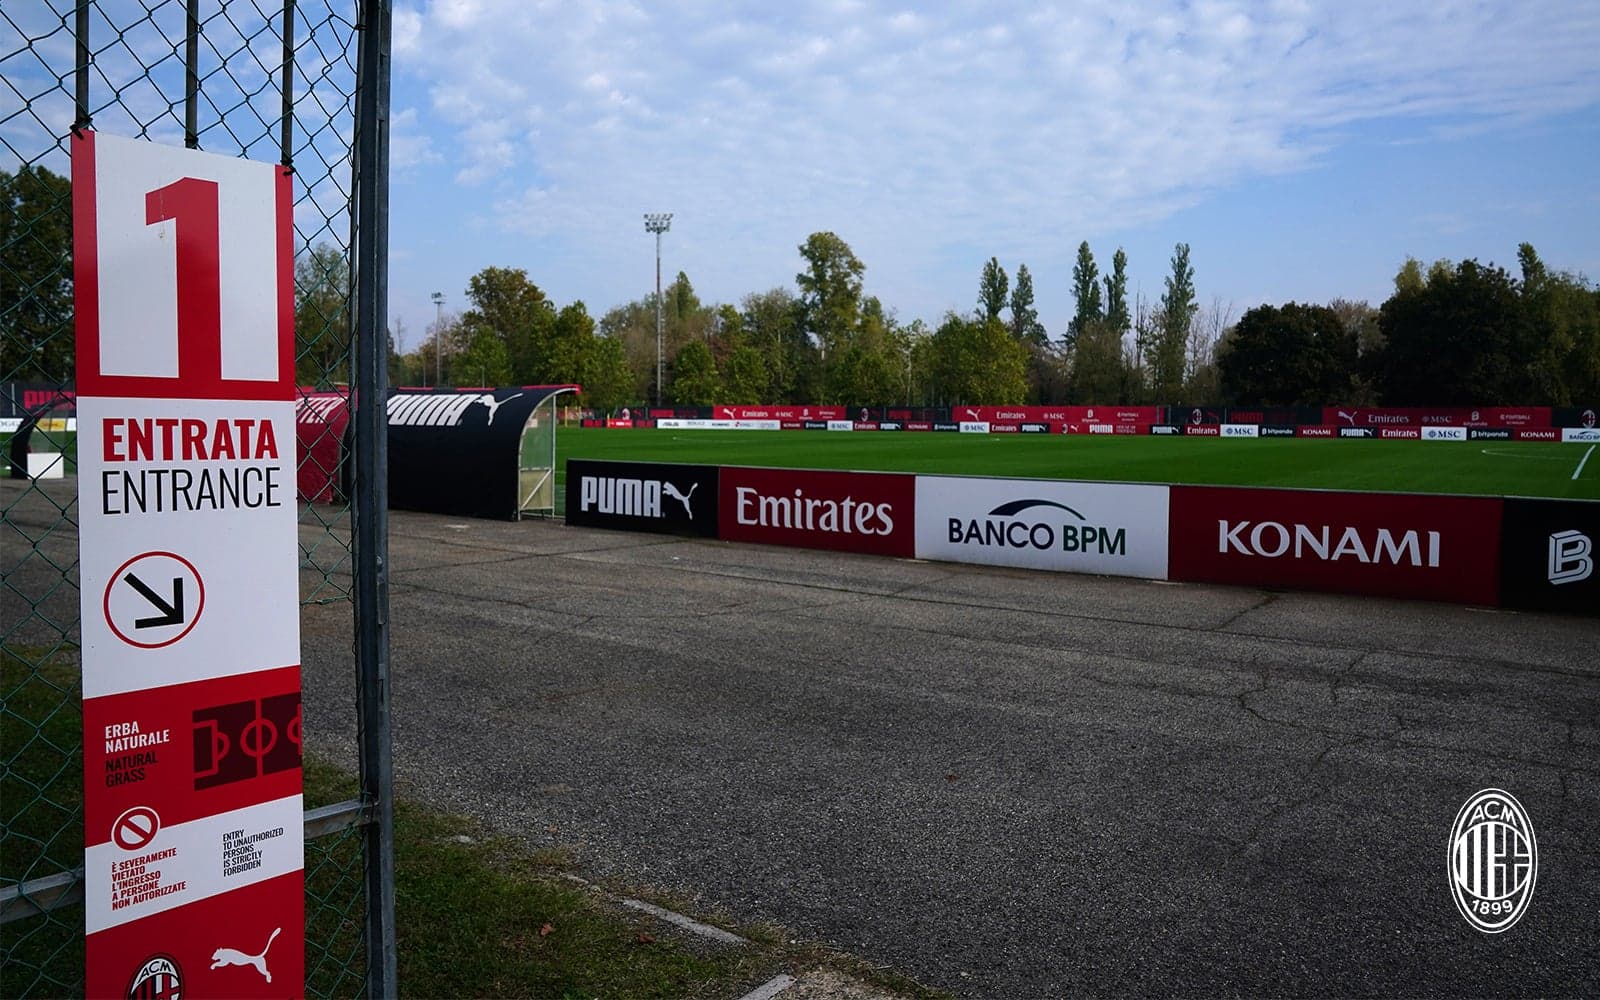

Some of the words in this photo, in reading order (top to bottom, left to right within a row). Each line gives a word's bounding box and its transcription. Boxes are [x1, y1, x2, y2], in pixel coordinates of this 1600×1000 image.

[145, 177, 222, 379] 1
[996, 411, 1026, 419] Emirates
[1368, 414, 1410, 424] Emirates
[1430, 415, 1452, 423] MSC
[991, 424, 1017, 432] Emirates
[1089, 424, 1113, 433] PUMA
[1187, 426, 1217, 435] Emirates
[1233, 427, 1253, 436] MSC
[1341, 428, 1365, 436] PUMA
[1382, 428, 1418, 438] Emirates
[1437, 430, 1461, 438] MSC
[103, 418, 278, 462] ENTRATA
[102, 467, 281, 515] ENTRANCE
[581, 476, 662, 518] PUMA
[736, 486, 894, 536] Emirates
[948, 518, 1055, 550] BANCO
[1062, 525, 1126, 556] BPM
[1218, 519, 1441, 567] KONAMI
[105, 721, 140, 739] ERBA
[105, 729, 170, 754] NATURALE
[105, 752, 158, 772] NATURAL
[105, 768, 145, 788] GRASS
[223, 829, 244, 842] ENTRY
[223, 842, 232, 850] TO
[233, 827, 284, 848] UNAUTHORIZED
[112, 861, 117, 873] È
[119, 847, 177, 871] SEVERAMENTE
[223, 844, 254, 859] PERSONS
[223, 859, 231, 868] IS
[231, 850, 263, 866] STRICTLY
[112, 866, 146, 882] VIETATO
[223, 859, 261, 877] FORBIDDEN
[112, 871, 161, 892] L'INGRESSO
[112, 892, 118, 901] A
[121, 880, 159, 898] PERSONE
[112, 898, 130, 911] NON
[132, 881, 187, 905] AUTORIZZATE
[139, 960, 172, 982] ACM
